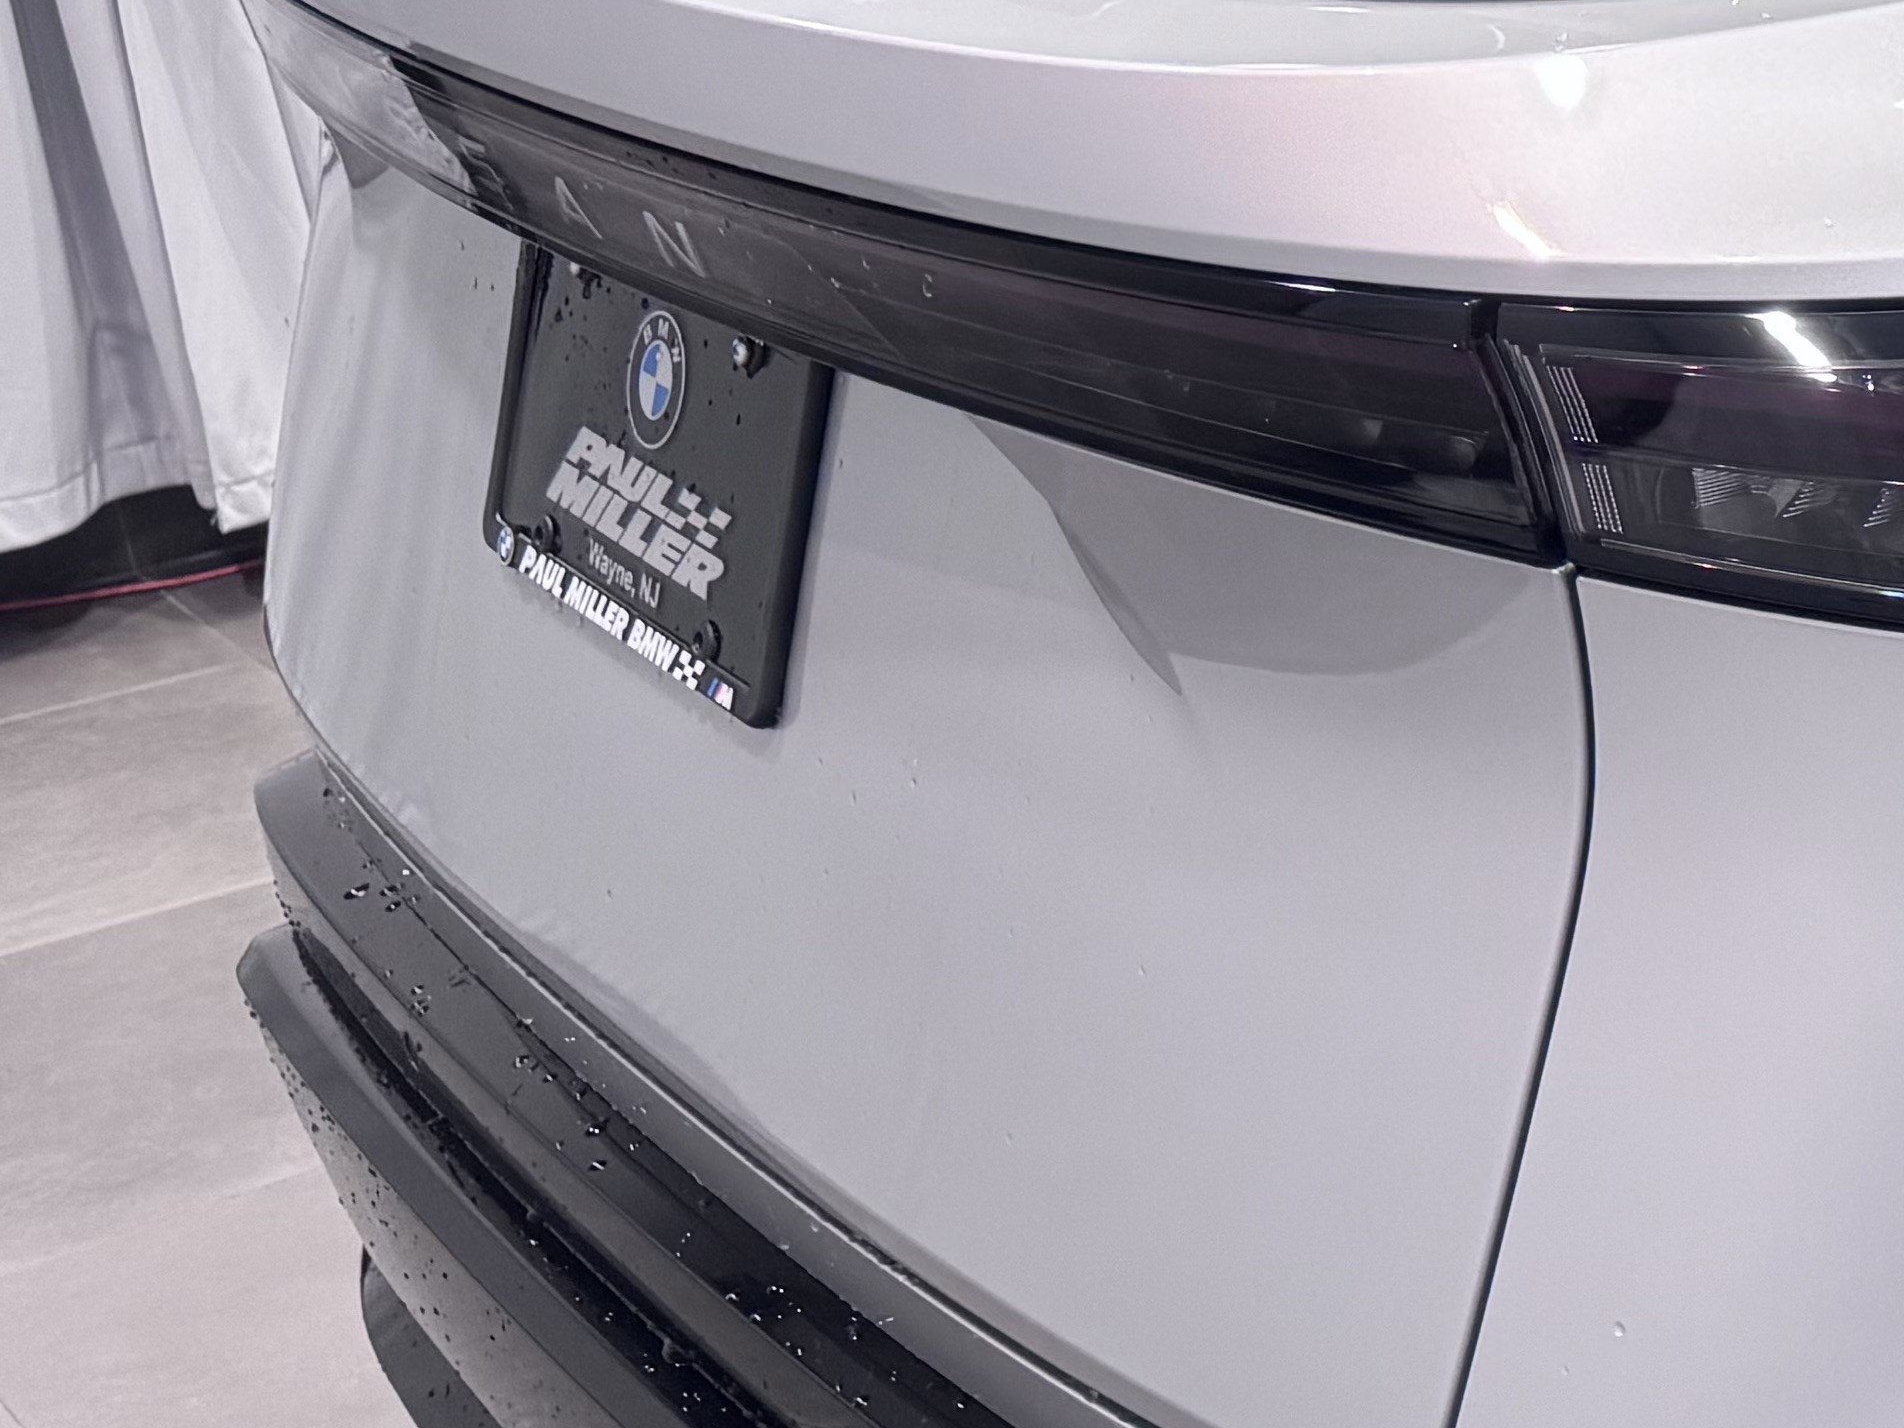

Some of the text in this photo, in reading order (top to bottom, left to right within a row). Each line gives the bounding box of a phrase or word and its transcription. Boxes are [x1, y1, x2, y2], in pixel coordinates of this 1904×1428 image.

[565, 426, 673, 520] PAUL
[546, 461, 724, 601] MILLER
[589, 537, 661, 609] Wayne, NJ
[519, 544, 567, 599] PAUL
[563, 576, 630, 641] MILLER
[627, 618, 680, 672] BMW
